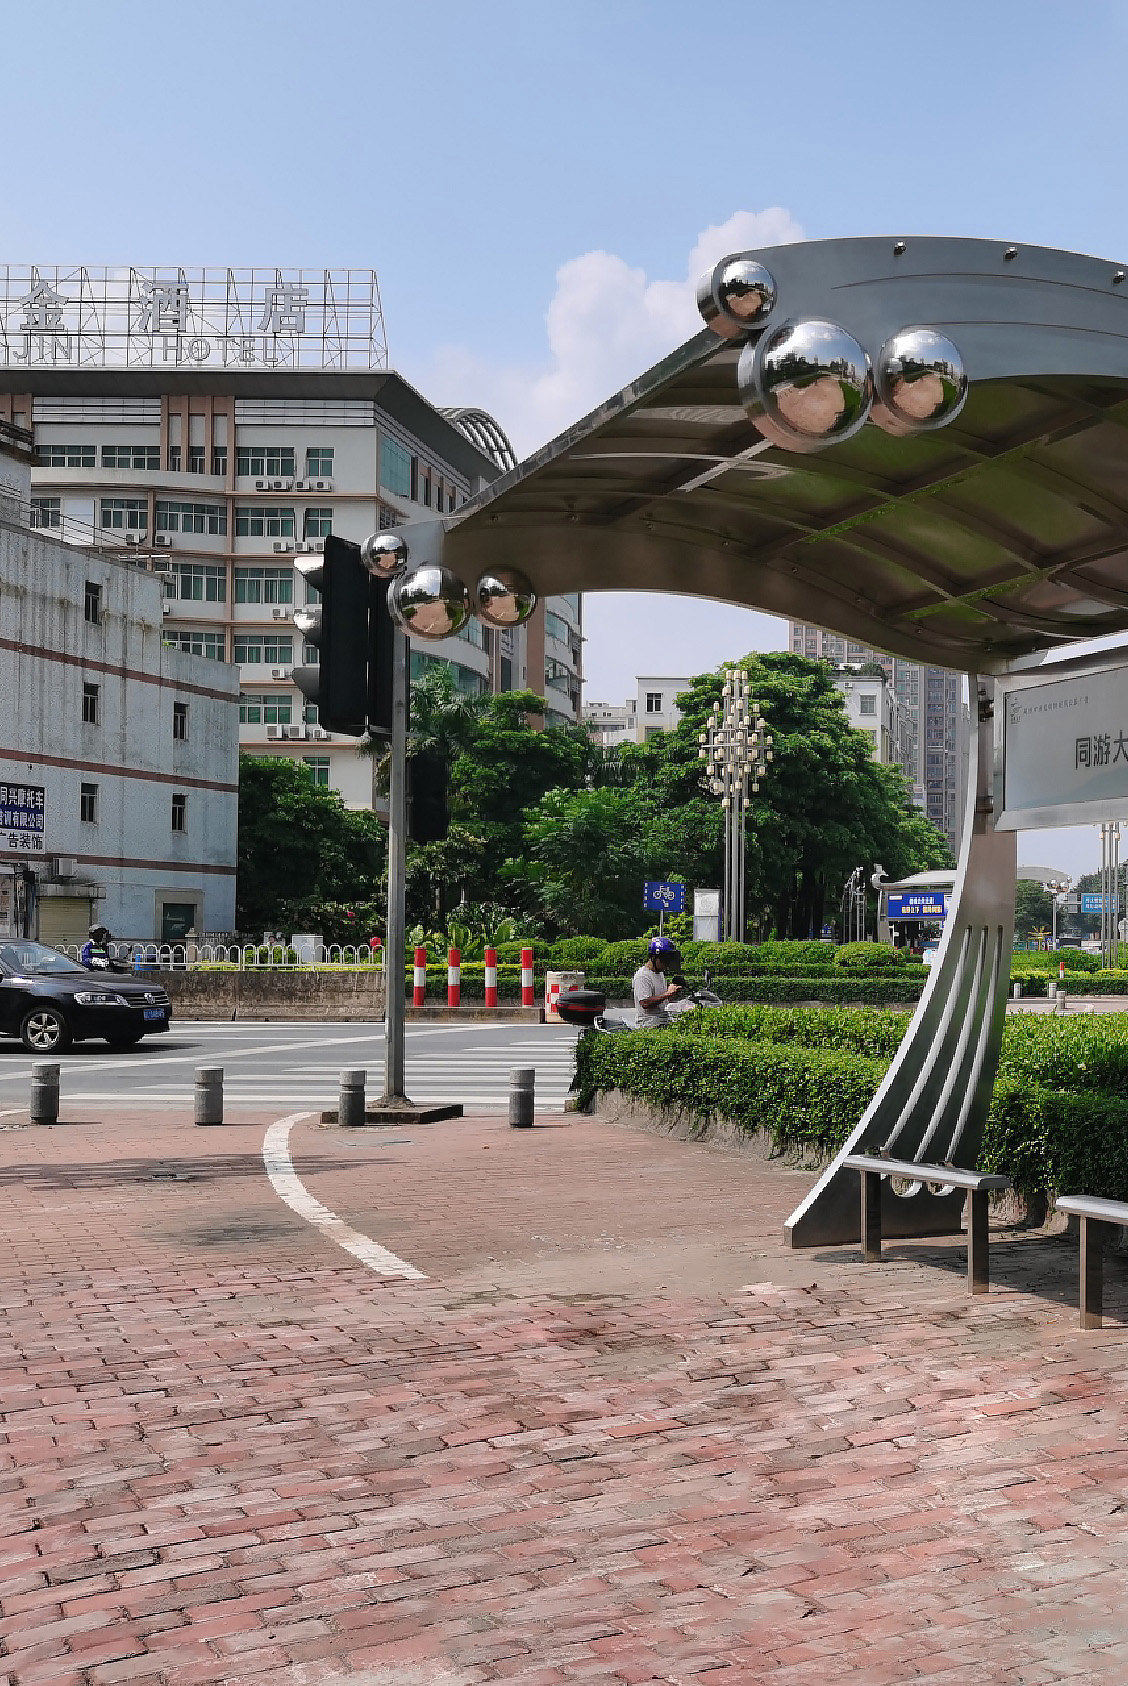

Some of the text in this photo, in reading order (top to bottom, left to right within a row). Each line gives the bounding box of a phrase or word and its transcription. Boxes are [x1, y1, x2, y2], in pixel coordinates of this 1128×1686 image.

[19, 281, 309, 333] 金酒店
[12, 336, 278, 362] JIN HOTEL
